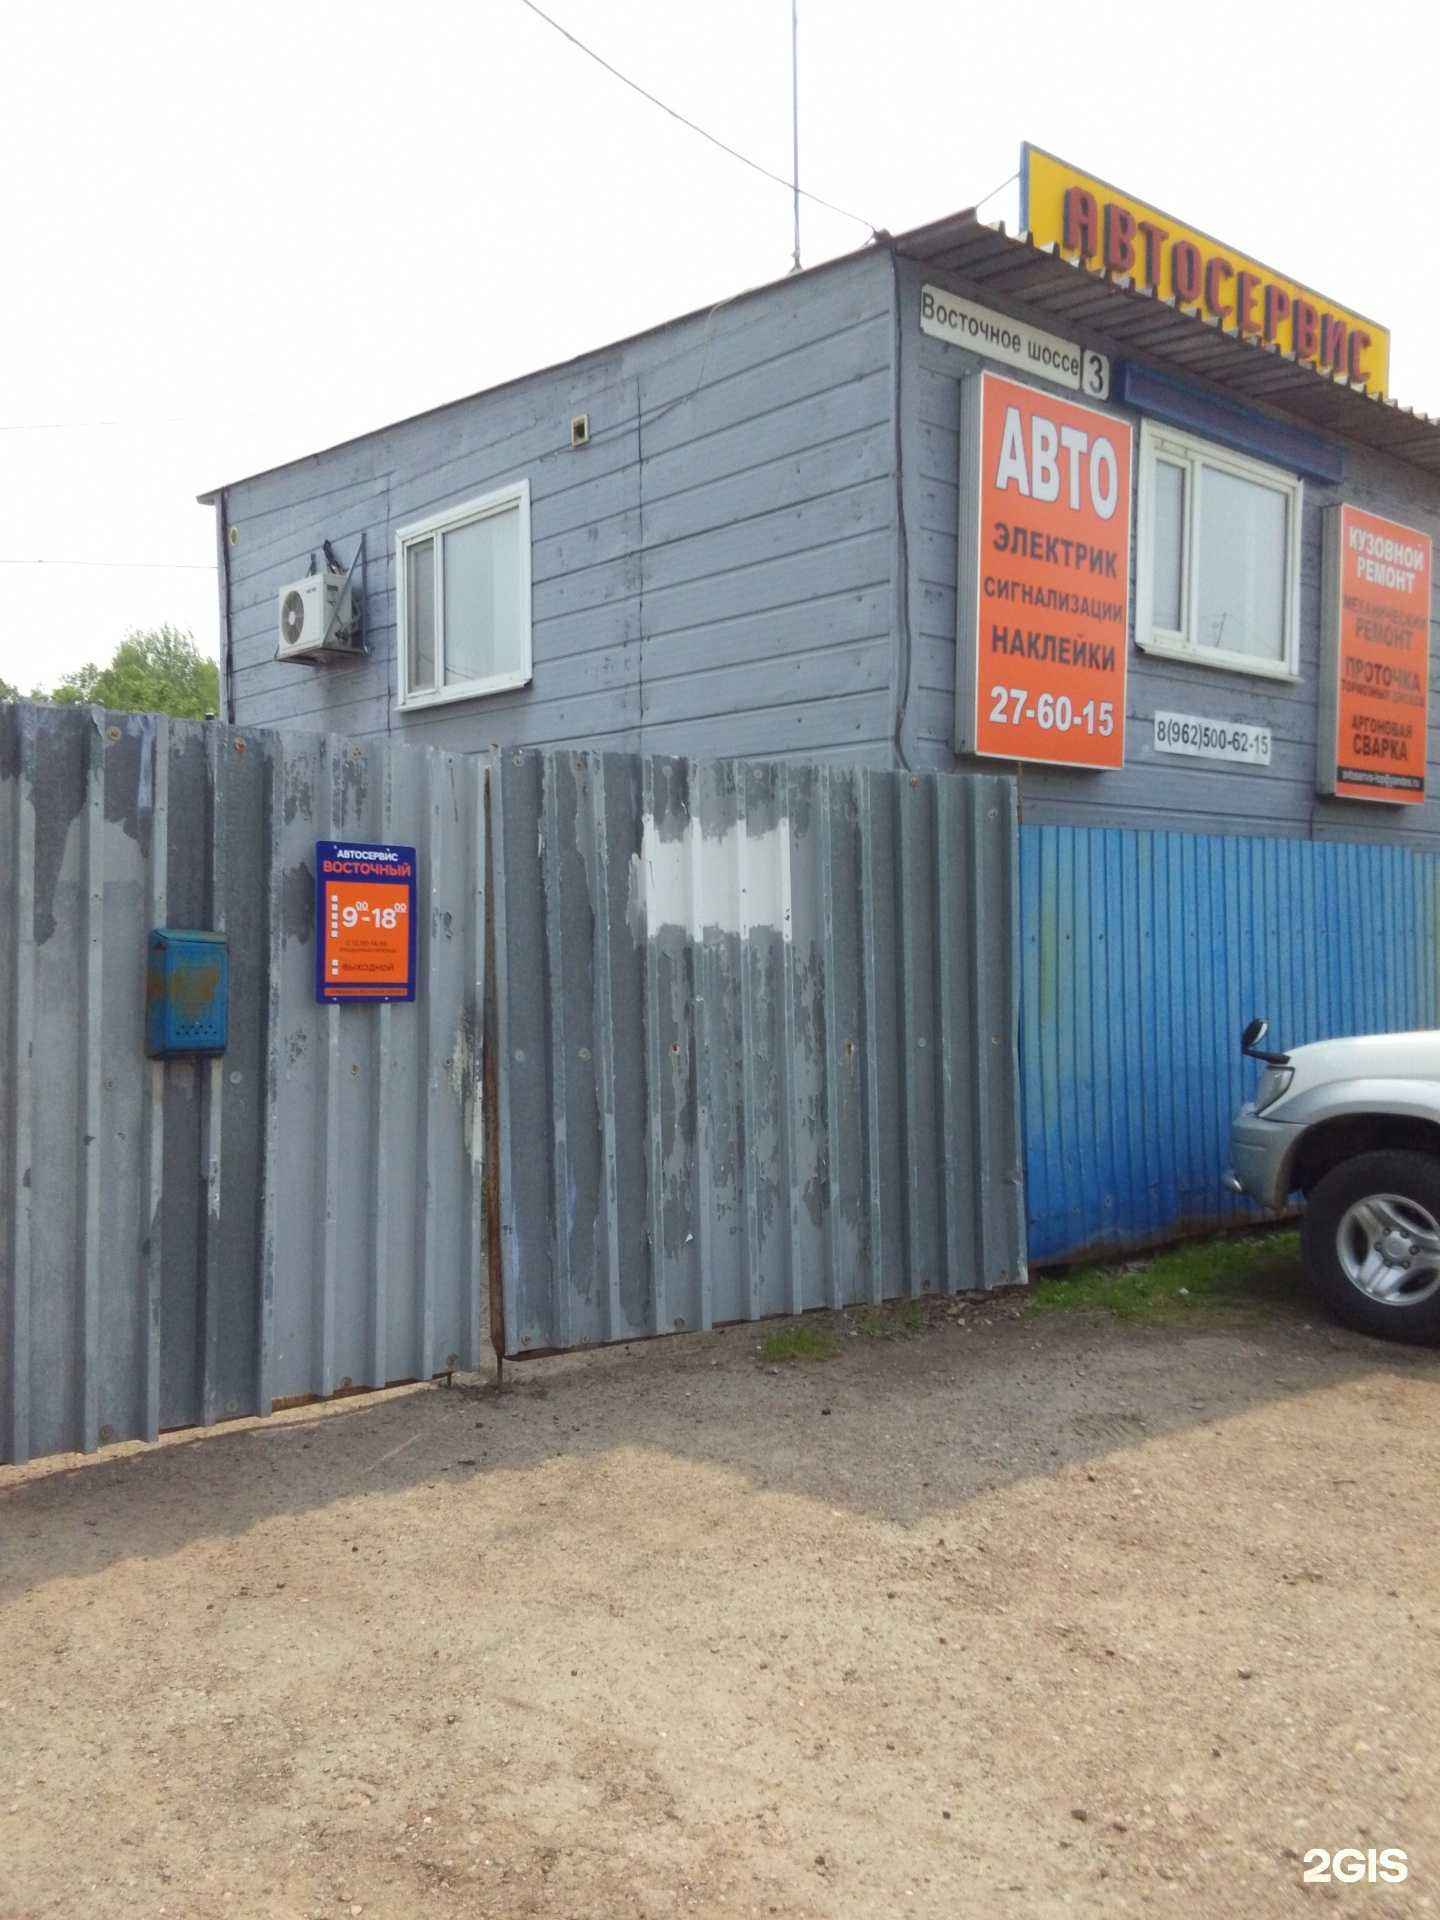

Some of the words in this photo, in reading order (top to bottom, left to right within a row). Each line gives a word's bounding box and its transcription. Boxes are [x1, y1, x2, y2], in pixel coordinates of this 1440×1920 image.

[1062, 184, 1373, 384] АВТОСЕРВИС
[921, 292, 1021, 353] Восточное
[1028, 340, 1080, 376] шоссе
[1088, 354, 1104, 394] 3
[994, 405, 1119, 520] АВТО
[992, 521, 1118, 579] ЭЛЕКТРИК
[1349, 526, 1424, 572] КУЗОВНОЙ
[1356, 555, 1415, 594] РЕМОНТ
[983, 575, 1123, 624] СИГНАЛИЗАЦИИ
[990, 624, 1116, 672] НАКЛЕЙКИ
[1344, 655, 1421, 693] ПРОТОЧКА
[988, 684, 1115, 738] 27-60-15
[1156, 718, 1269, 756] 8(962)500-62-15
[1352, 733, 1409, 762] СВАРКА
[322, 860, 412, 877] ВОСТОЧНЫЙ
[336, 849, 399, 862] АВТОСЕРВИС
